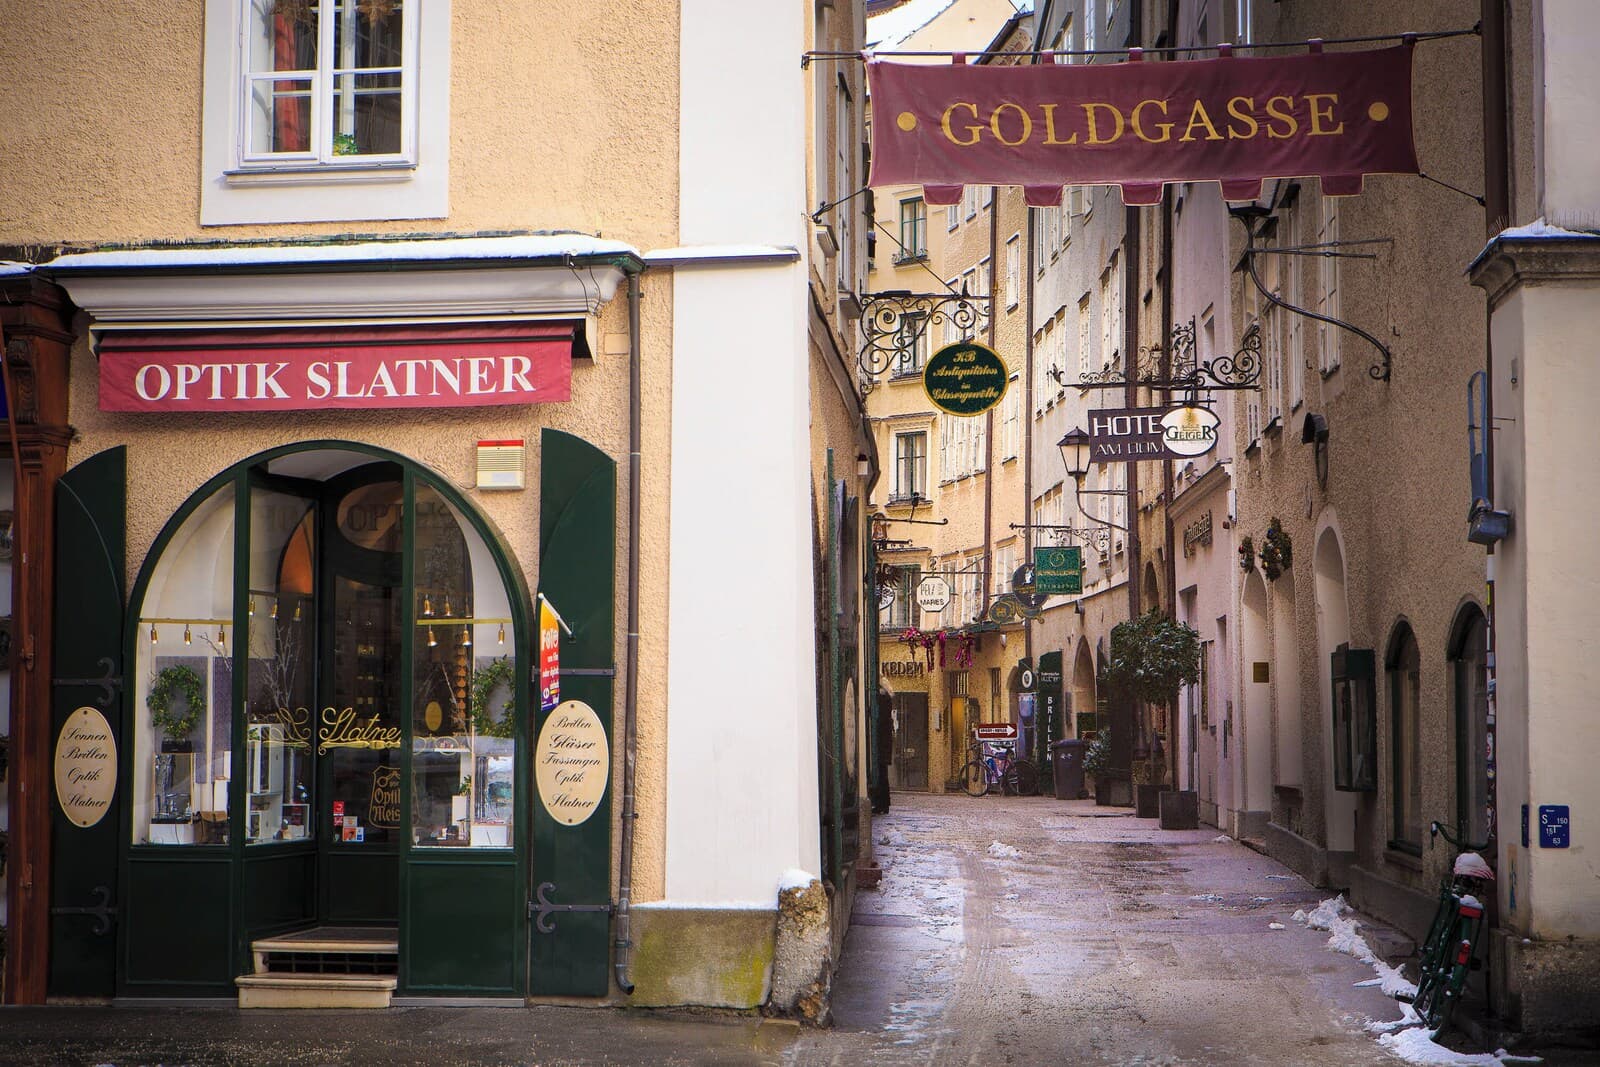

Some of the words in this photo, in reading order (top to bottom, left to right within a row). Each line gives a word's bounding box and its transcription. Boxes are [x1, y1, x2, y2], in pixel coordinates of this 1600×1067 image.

[941, 93, 1344, 146] GOLDGASSE
[135, 363, 291, 402] OPTIK
[306, 355, 536, 400] SLATNER
[1093, 414, 1162, 437] HOTE
[1096, 442, 1121, 456] AM
[1127, 441, 1165, 454] DOM
[882, 661, 924, 677] KEDEM
[319, 706, 401, 741] Slatne
[553, 716, 592, 729] Brillen
[63, 728, 108, 741] Sonnen
[549, 734, 597, 749] Gläser
[62, 746, 108, 760] Brillen
[542, 751, 601, 768] Fassungen
[67, 767, 103, 784] Optik
[555, 769, 585, 786] Optik
[63, 793, 107, 808] Slatner
[548, 793, 595, 808] Slatner
[372, 804, 401, 822] Meis
[1542, 814, 1548, 824] S
